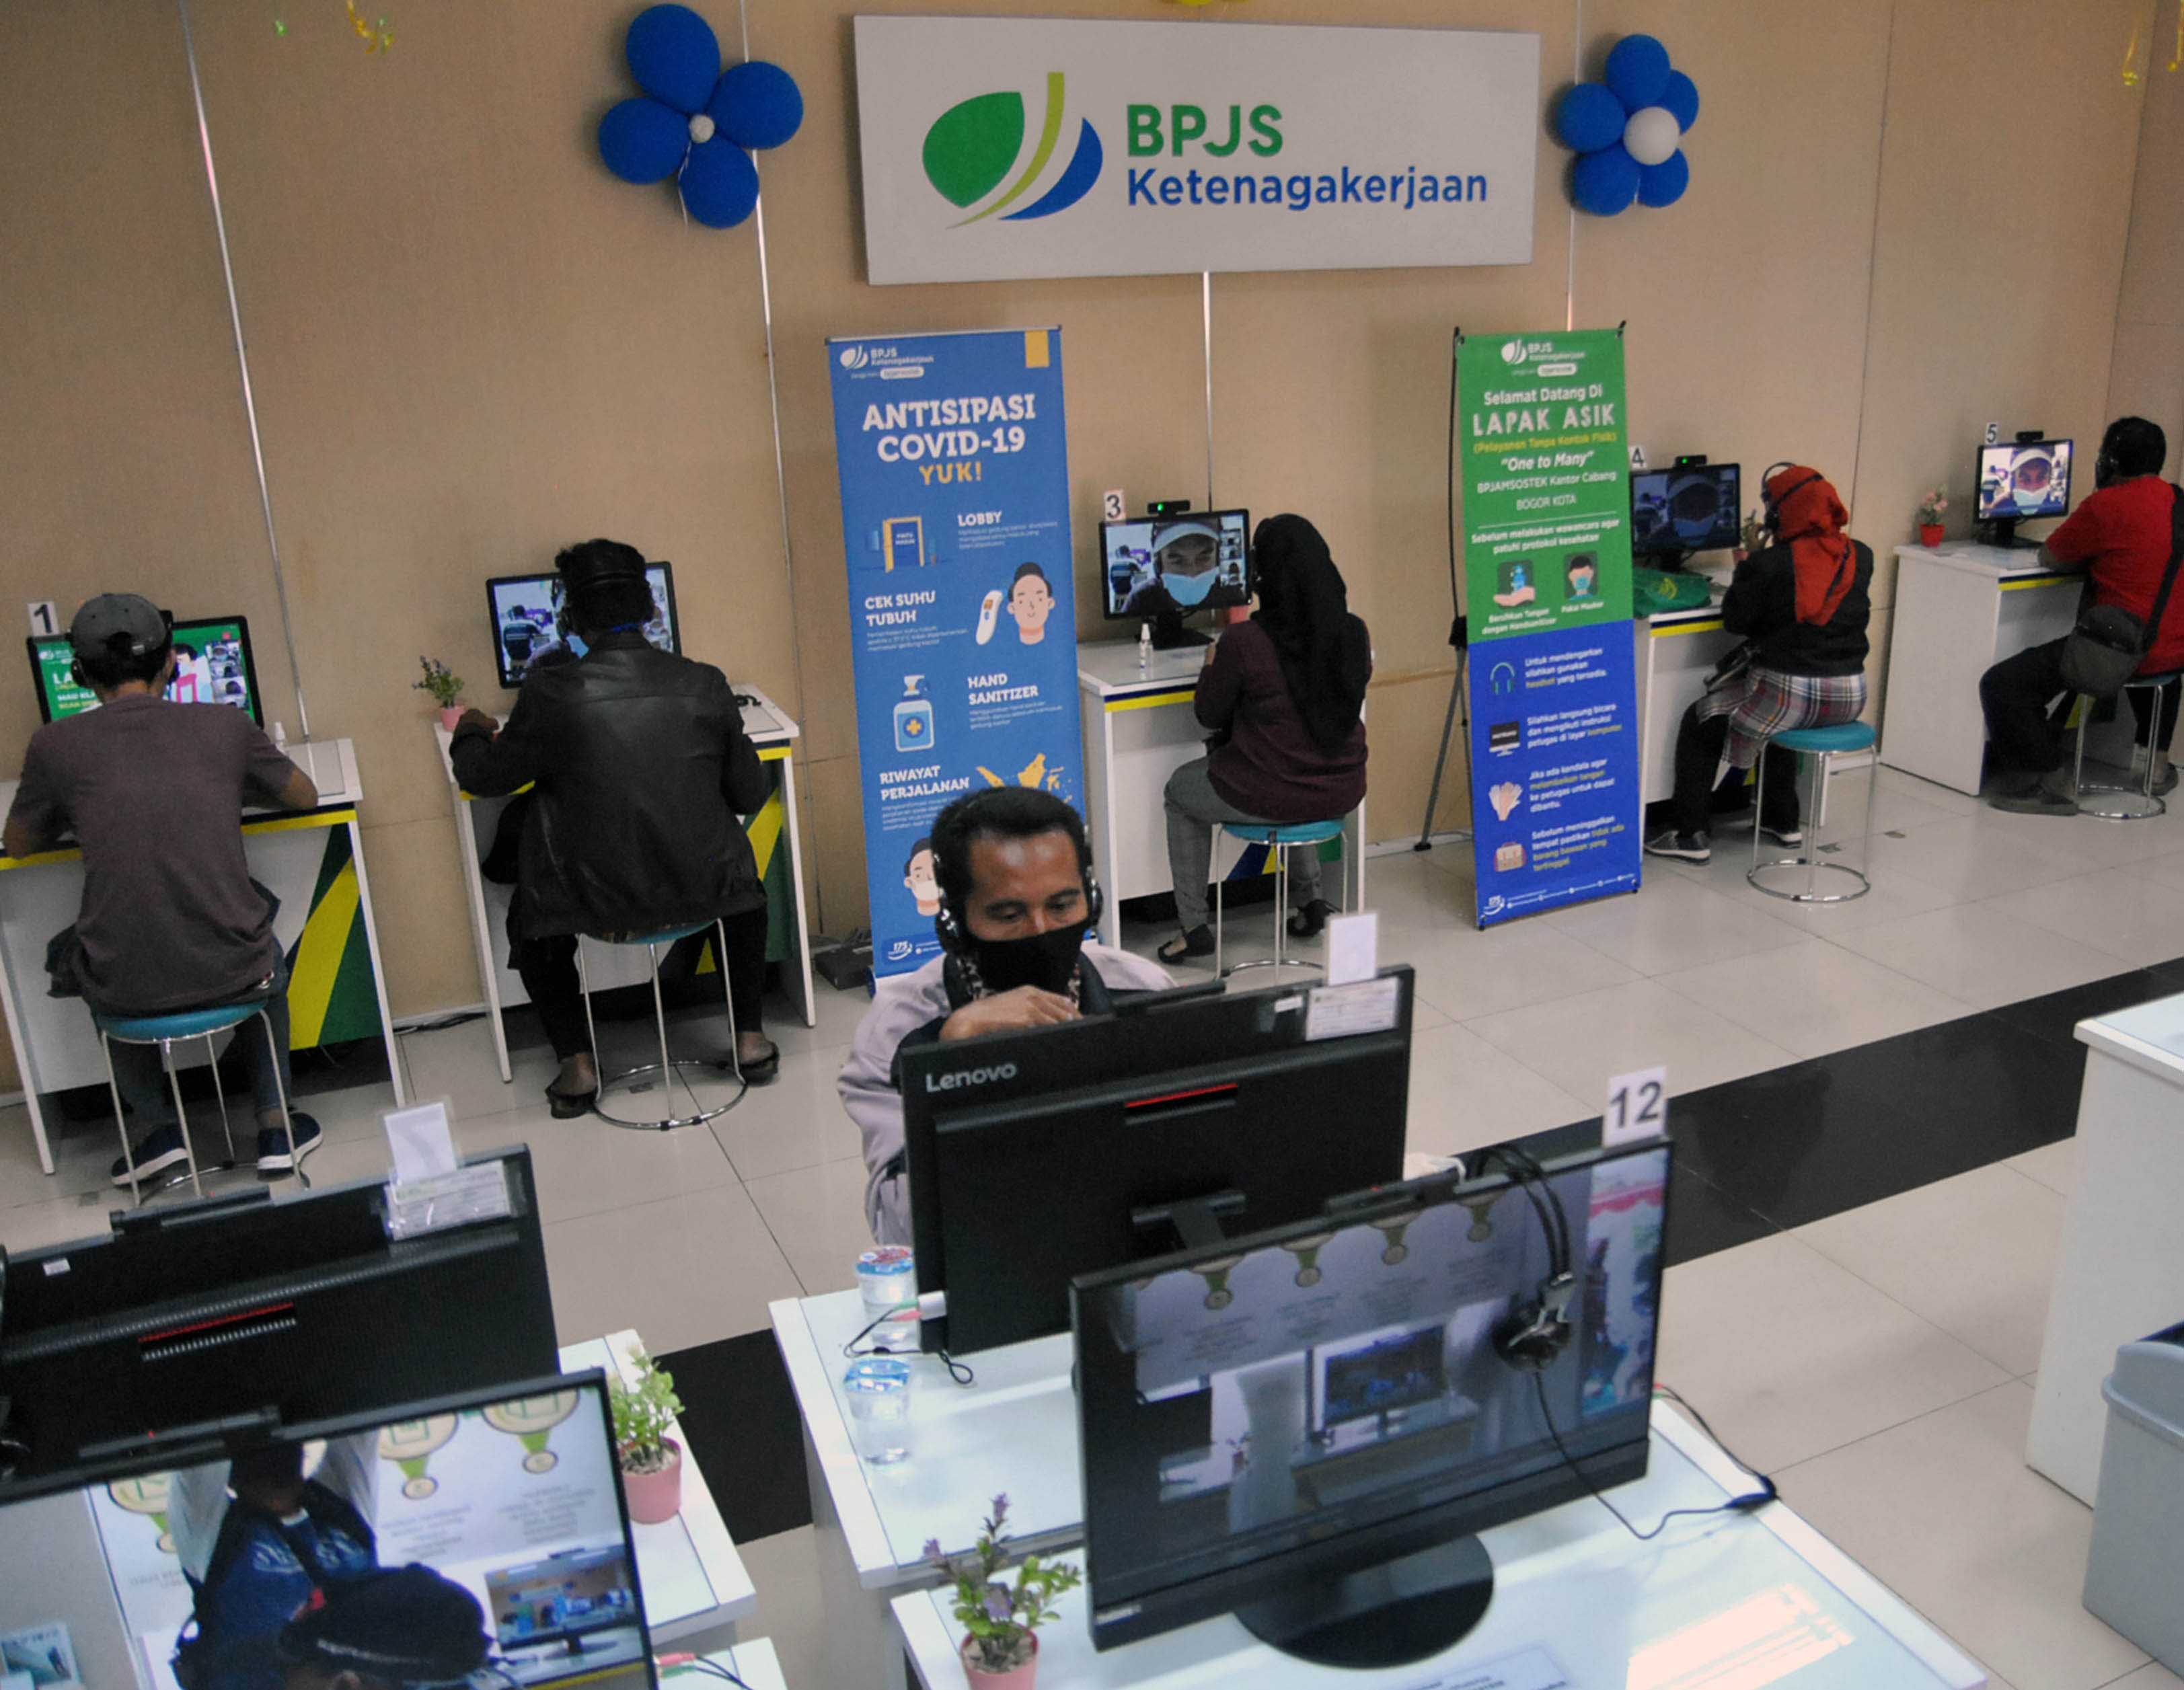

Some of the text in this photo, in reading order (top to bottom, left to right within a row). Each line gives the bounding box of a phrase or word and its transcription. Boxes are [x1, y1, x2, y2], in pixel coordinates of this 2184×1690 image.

[1127, 104, 1283, 158] BPJS
[1127, 166, 1487, 211] Ketenagakerjaan
[871, 348, 897, 358] BPJS
[1484, 384, 1603, 406] Selamat Datang Di
[862, 393, 1037, 431] ANTISIPASI
[1473, 403, 1614, 436] LAPAK ASIK
[877, 426, 1026, 462] COVID-19
[1987, 424, 1996, 443] 5
[1538, 455, 1550, 468] to
[1632, 447, 1644, 467] 4
[919, 461, 982, 486] YUK!
[1477, 471, 1616, 493] BPJAMSOSTEK Kantor Cabang
[1107, 494, 1121, 518] 3
[1517, 494, 1576, 510] BOGOR KOTA
[957, 510, 1002, 527] LOBBY
[865, 590, 936, 610] CEK SUHU
[34, 605, 52, 633] 1
[866, 609, 917, 627] TUBUH
[968, 673, 1008, 689] HAND
[968, 685, 1039, 705] SANITIZER
[880, 765, 941, 785] RIWAYAT
[880, 777, 970, 800] PERJALANAN
[926, 1063, 1016, 1093] Lenovo
[1610, 1081, 1661, 1128] 12
